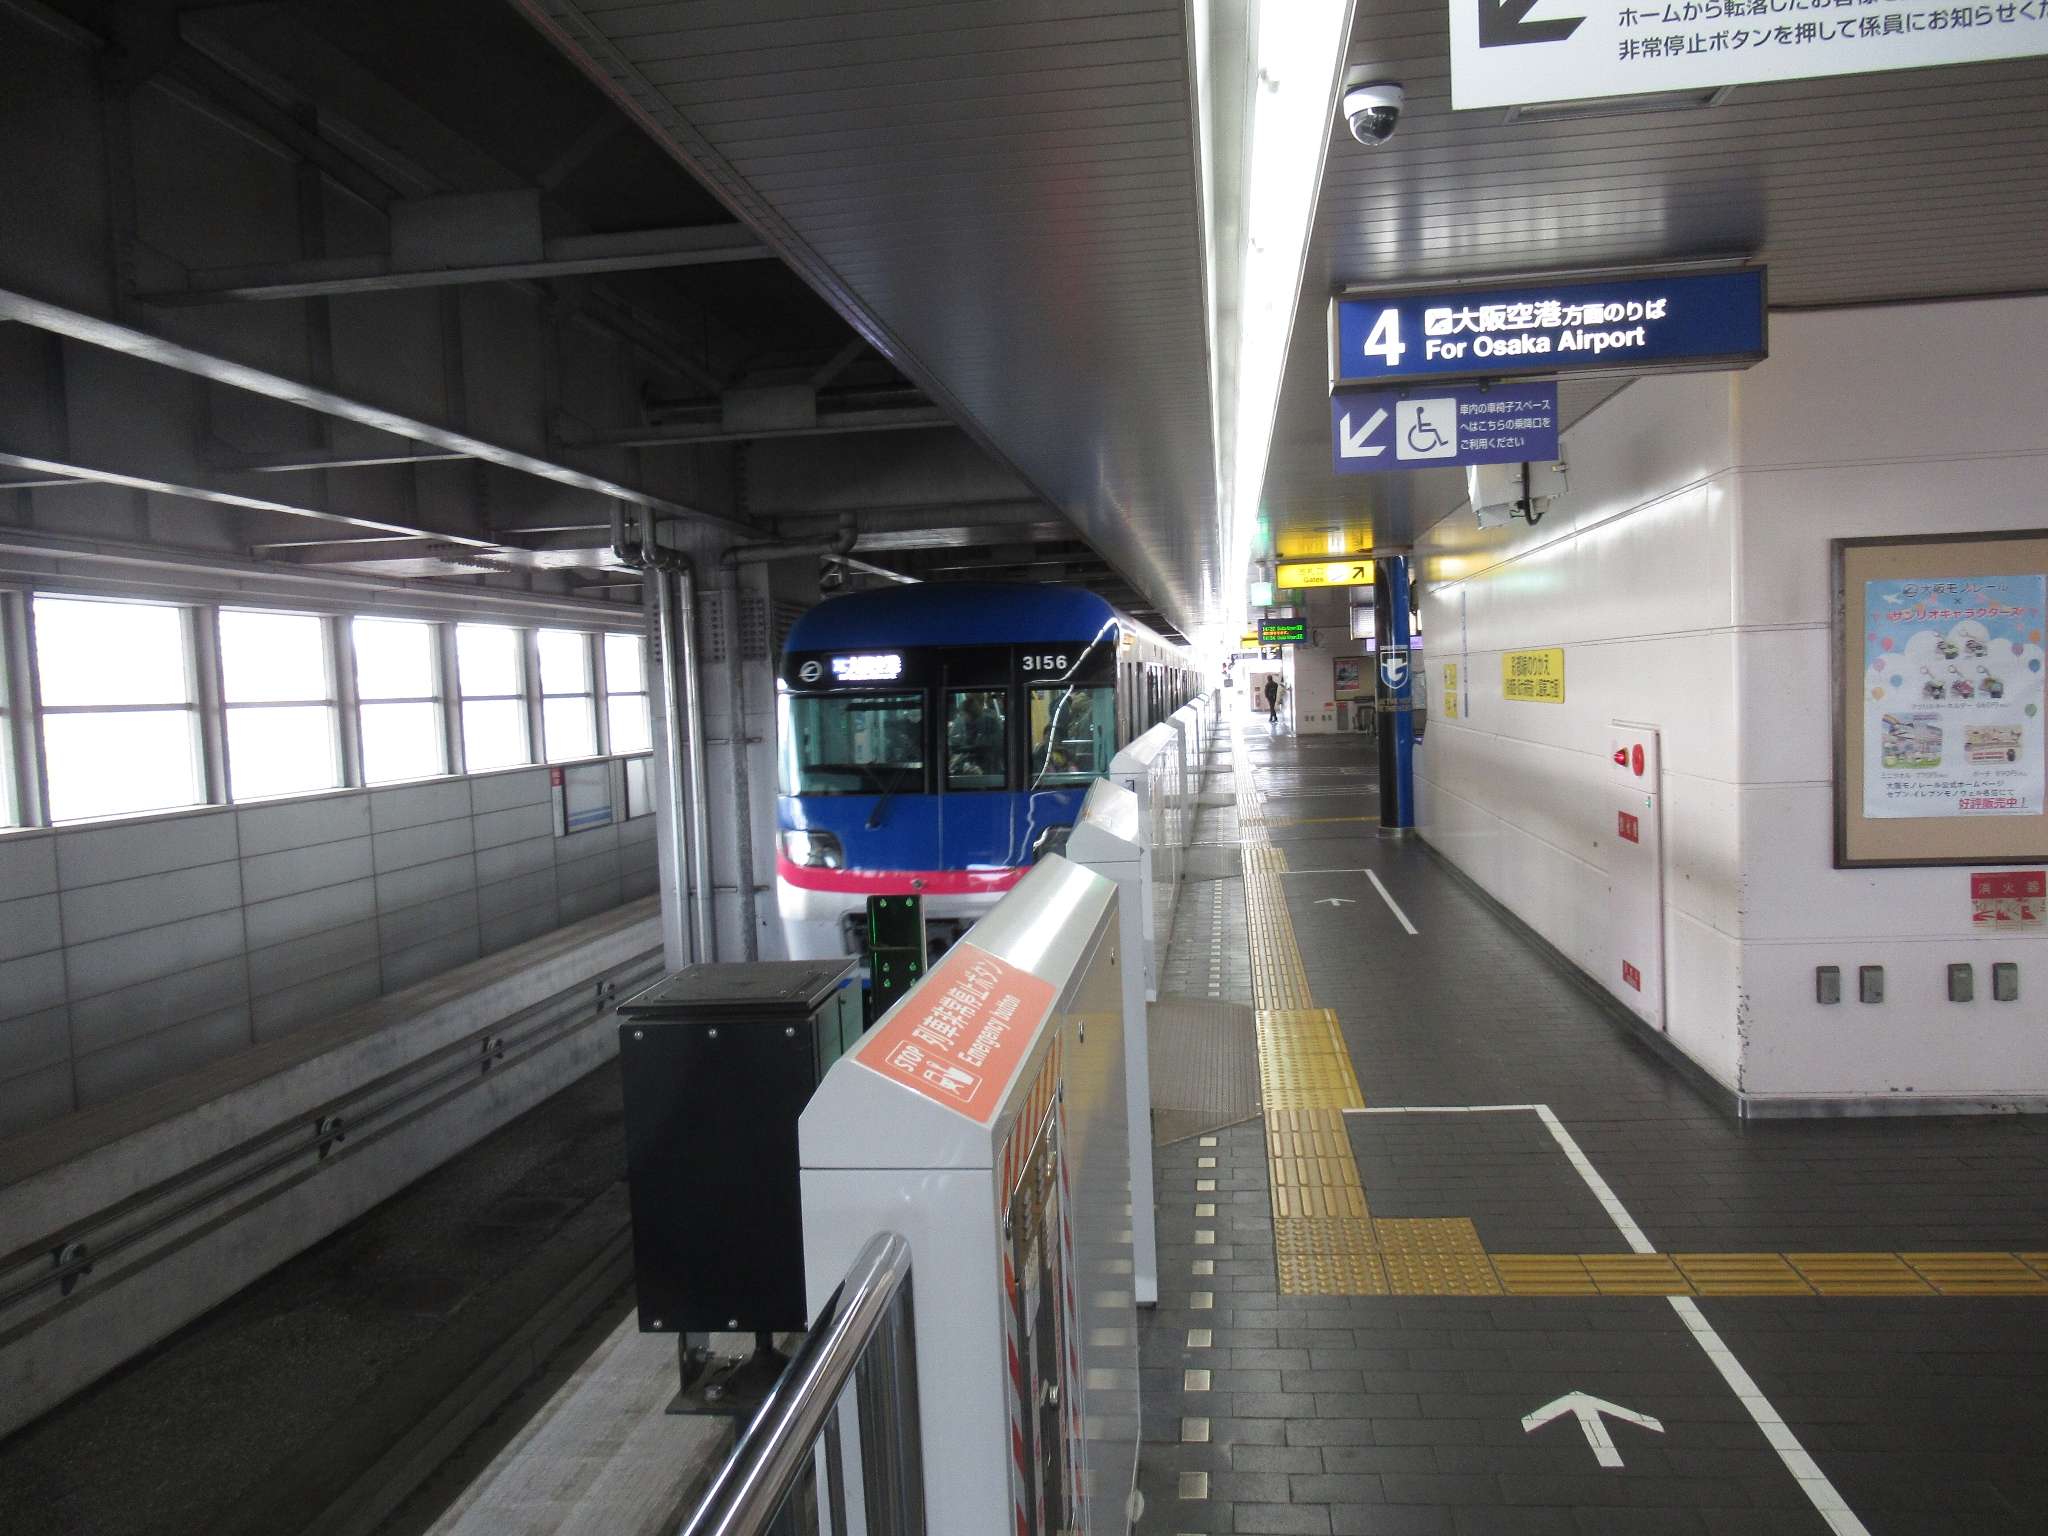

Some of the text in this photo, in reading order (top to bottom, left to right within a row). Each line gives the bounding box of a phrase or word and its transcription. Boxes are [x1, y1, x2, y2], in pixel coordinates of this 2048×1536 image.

[1452, 299, 1667, 333] 大阪空港方面のりば
[1364, 308, 1406, 366] 4
[1426, 326, 1645, 360] For Osaka Airport
[1460, 437, 1525, 450] ご利用ください
[1023, 655, 1067, 670] 3156
[911, 958, 1003, 1052] 列車非常停止ボタン
[957, 994, 1021, 1068] Emergency button
[893, 1045, 926, 1072] STOP
